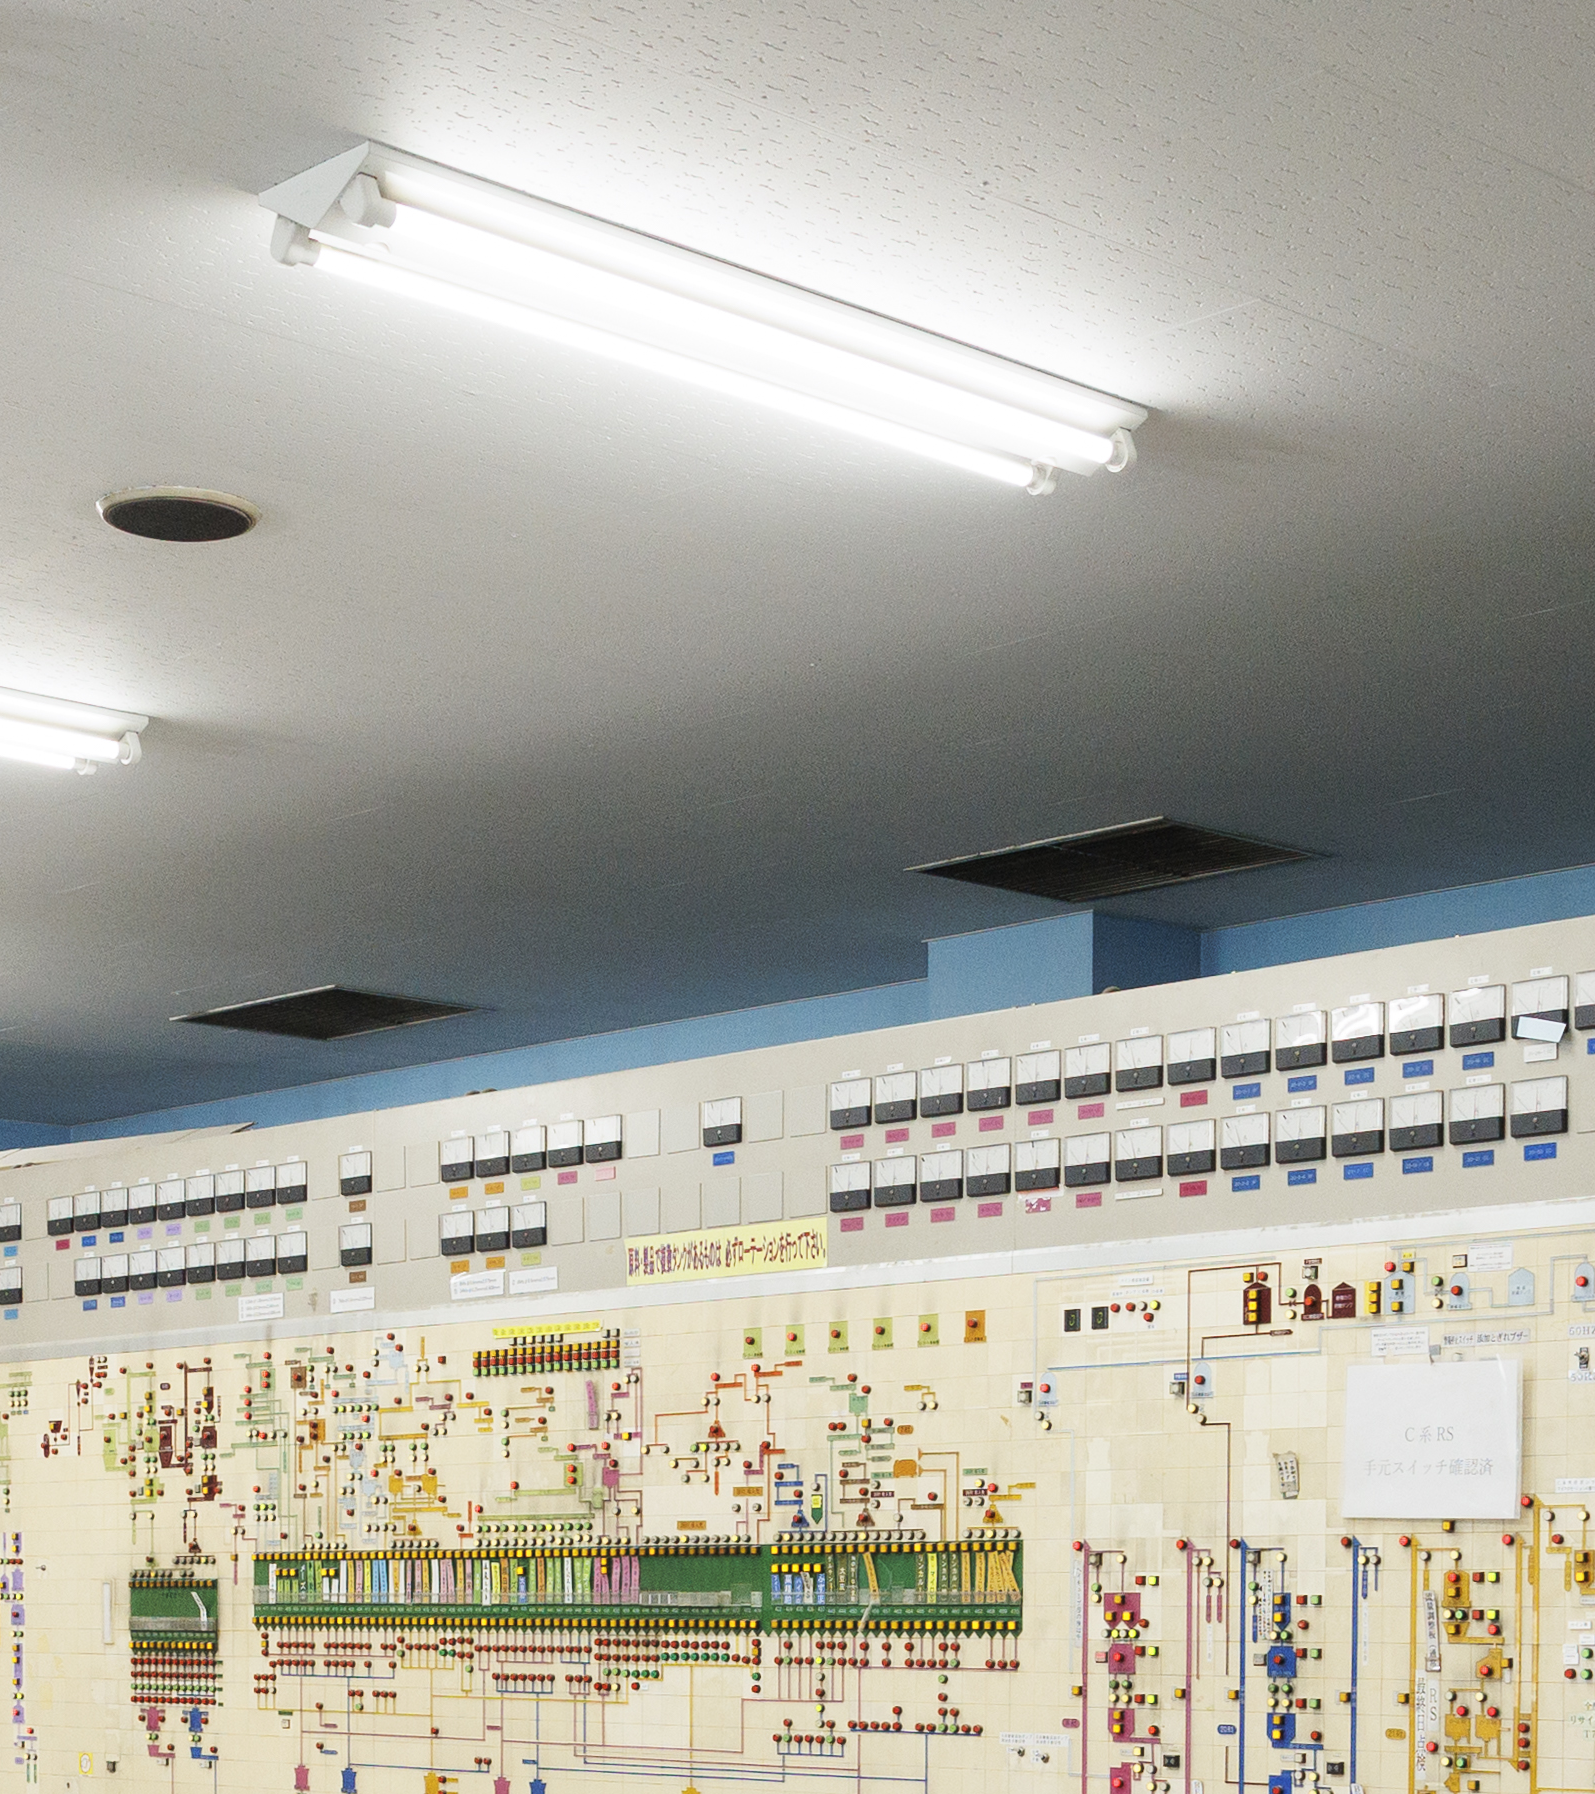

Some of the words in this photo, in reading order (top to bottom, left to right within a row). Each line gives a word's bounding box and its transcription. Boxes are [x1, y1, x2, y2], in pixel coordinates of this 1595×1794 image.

[1419, 1426, 1432, 1444] 系
[1436, 1426, 1455, 1443] RS
[1363, 1458, 1494, 1477] 手元スイッチ確認済
